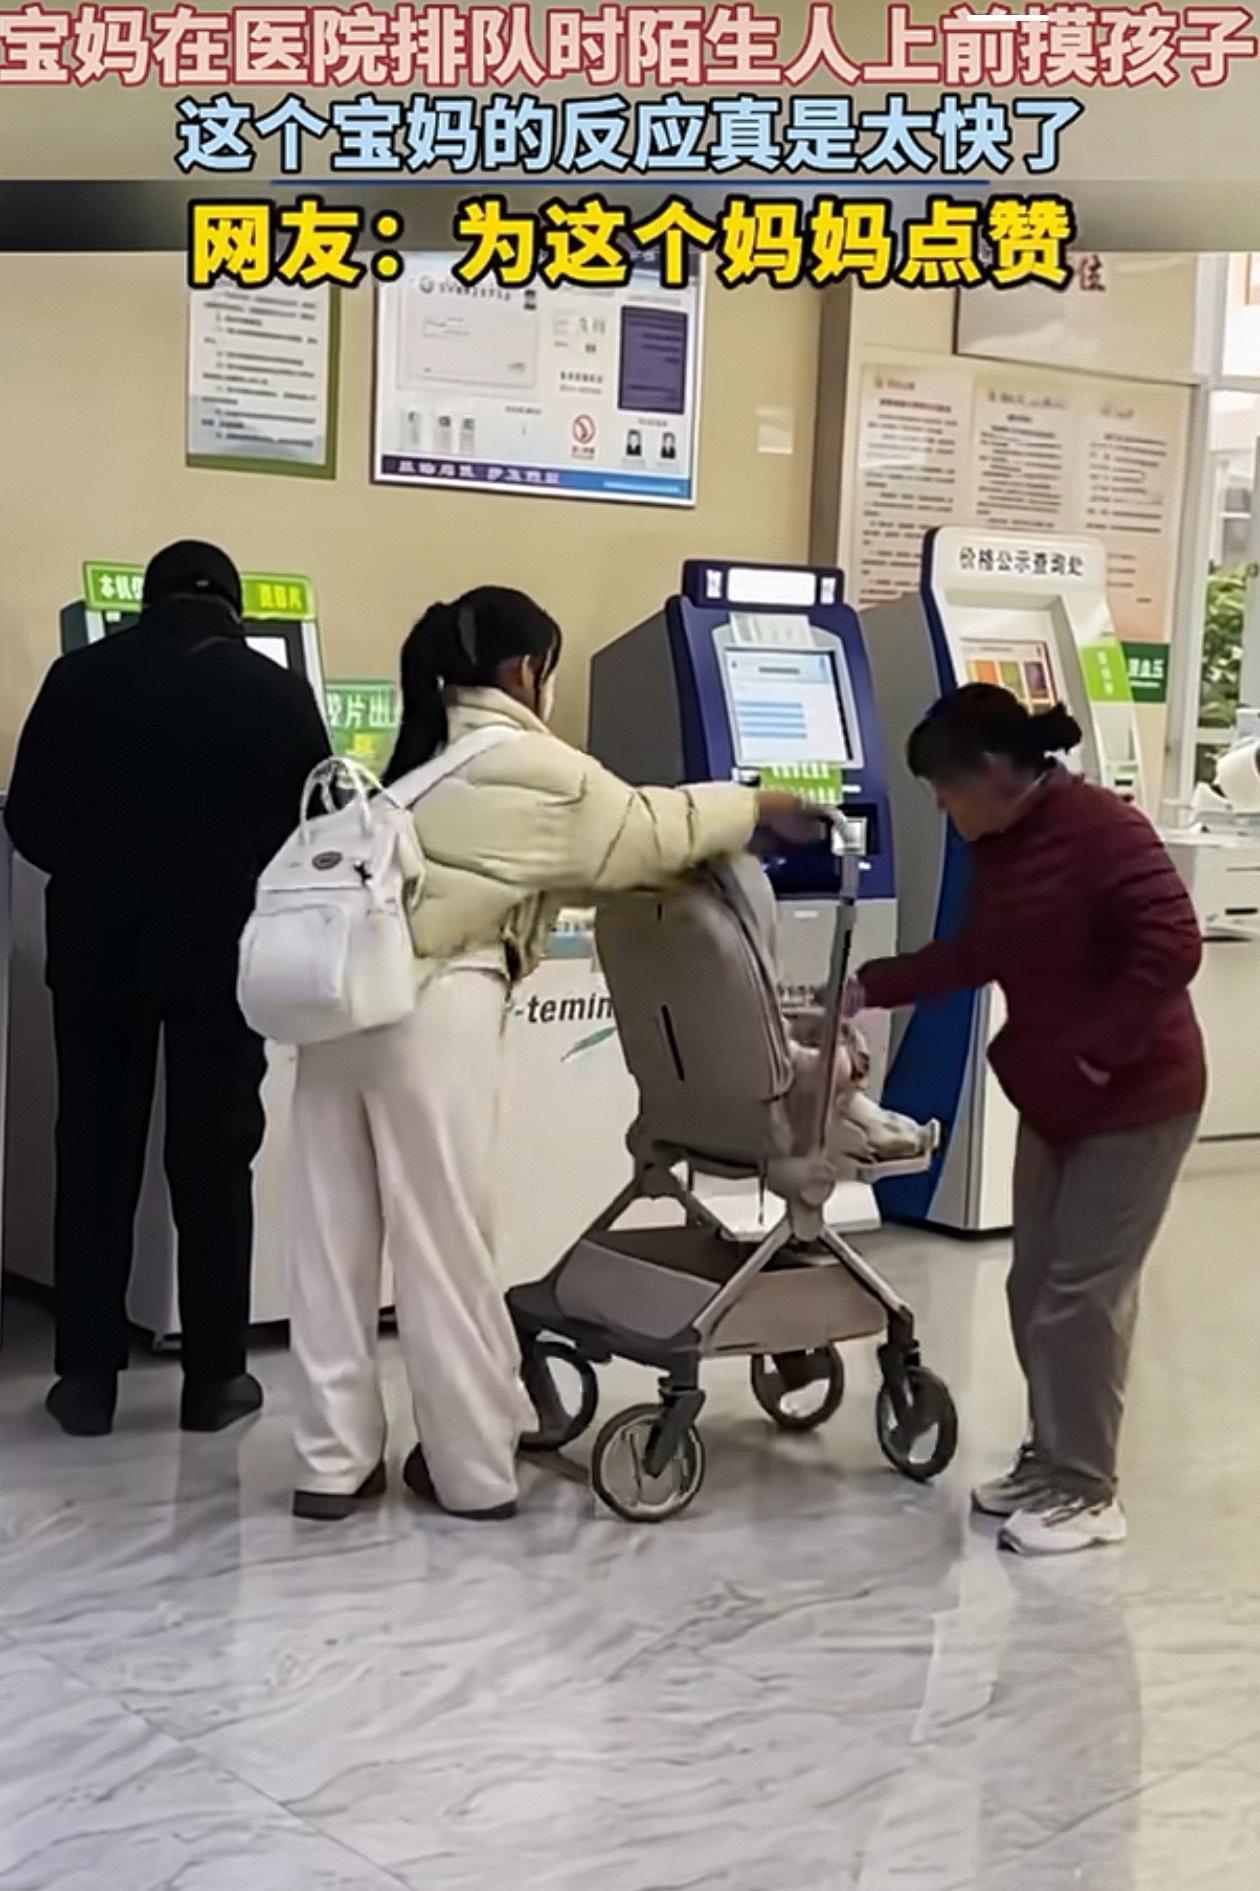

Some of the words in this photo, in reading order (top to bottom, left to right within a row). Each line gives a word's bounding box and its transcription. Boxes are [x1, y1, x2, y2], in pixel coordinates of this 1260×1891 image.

[959, 545, 1084, 576] 价格公示查询处
